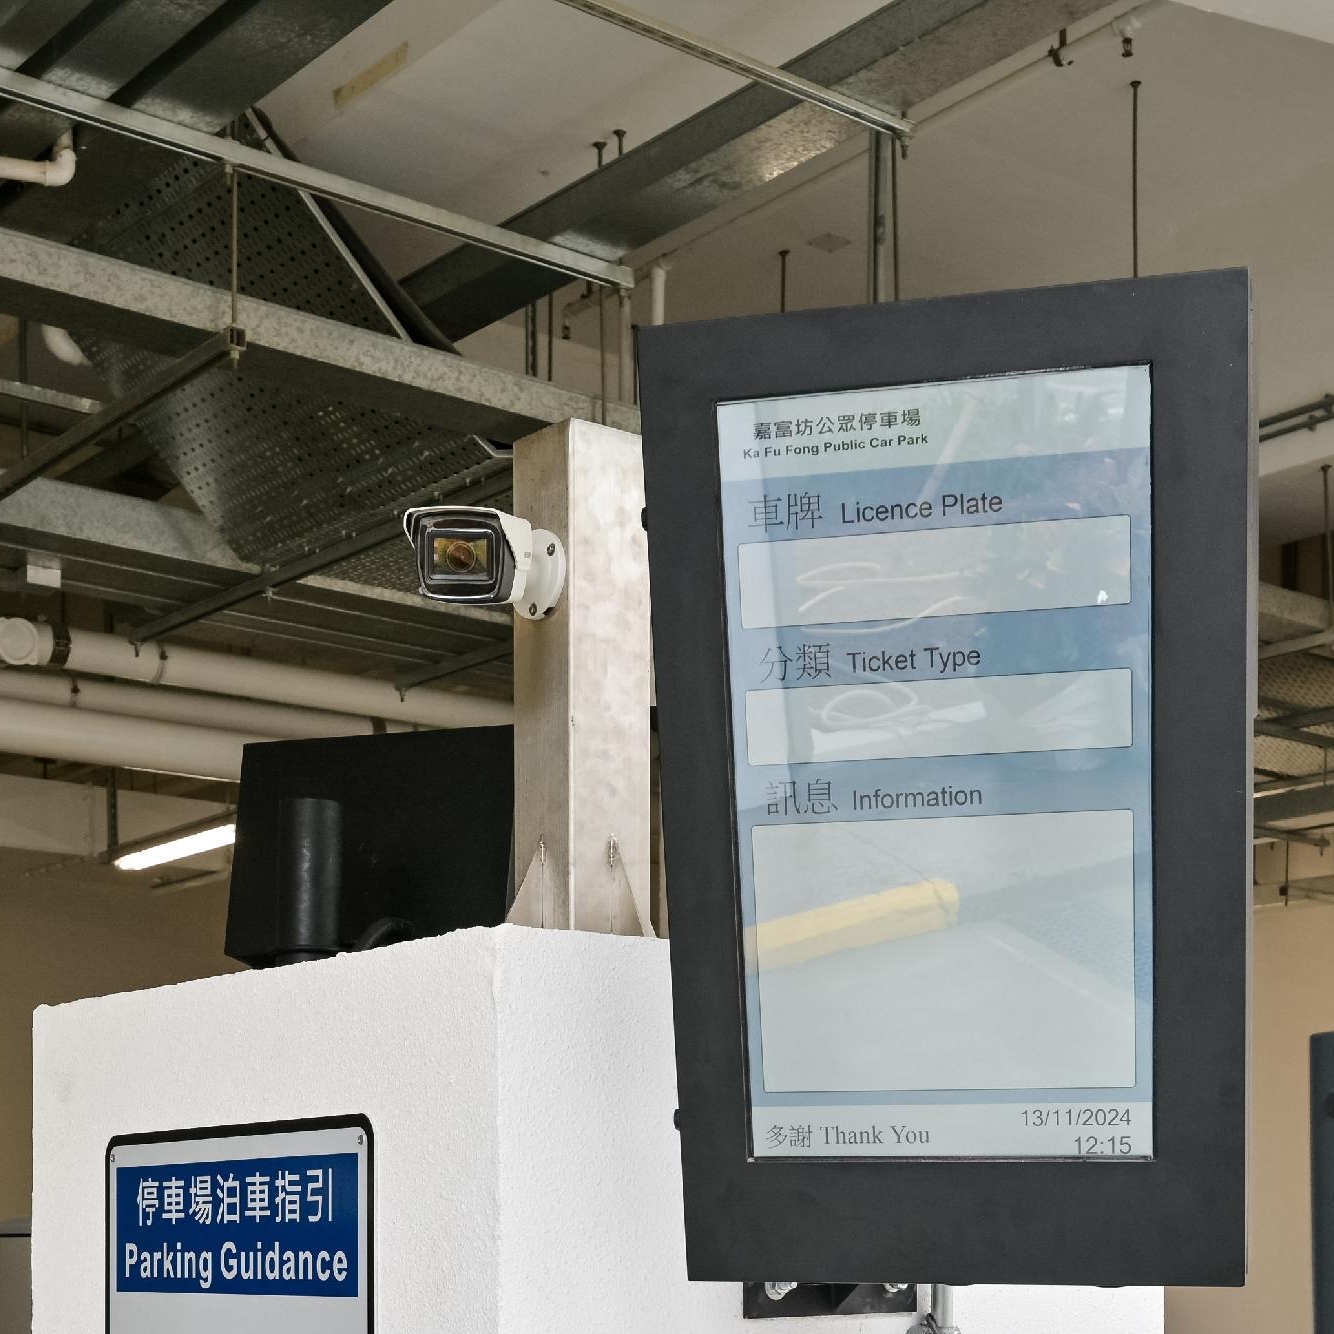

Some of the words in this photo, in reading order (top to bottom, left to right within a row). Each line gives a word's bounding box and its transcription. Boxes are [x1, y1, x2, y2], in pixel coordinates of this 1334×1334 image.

[753, 407, 922, 441] 嘉富坊公眾停車場
[743, 446, 760, 459] Ka
[764, 444, 781, 458] Fu
[785, 441, 820, 459] Fong
[824, 438, 866, 453] Public
[870, 436, 894, 449] Car
[897, 432, 929, 446] Park
[747, 491, 823, 534] 車牌
[841, 496, 933, 525] Licence
[942, 492, 1003, 517] Plate
[759, 642, 832, 683] 分類
[846, 649, 917, 674] Ticket
[923, 646, 982, 673] Type
[764, 778, 839, 817] 訊息
[853, 785, 983, 811] Information
[1021, 1107, 1132, 1129] 13/11/2024
[764, 1123, 813, 1150] 多謝
[819, 1124, 884, 1146] Thank
[890, 1124, 931, 1145] You
[1073, 1134, 1133, 1155] 12:15
[136, 1168, 333, 1226] 停車場泊車指引
[125, 1242, 213, 1288] Parking
[220, 1241, 348, 1281] Guidance
